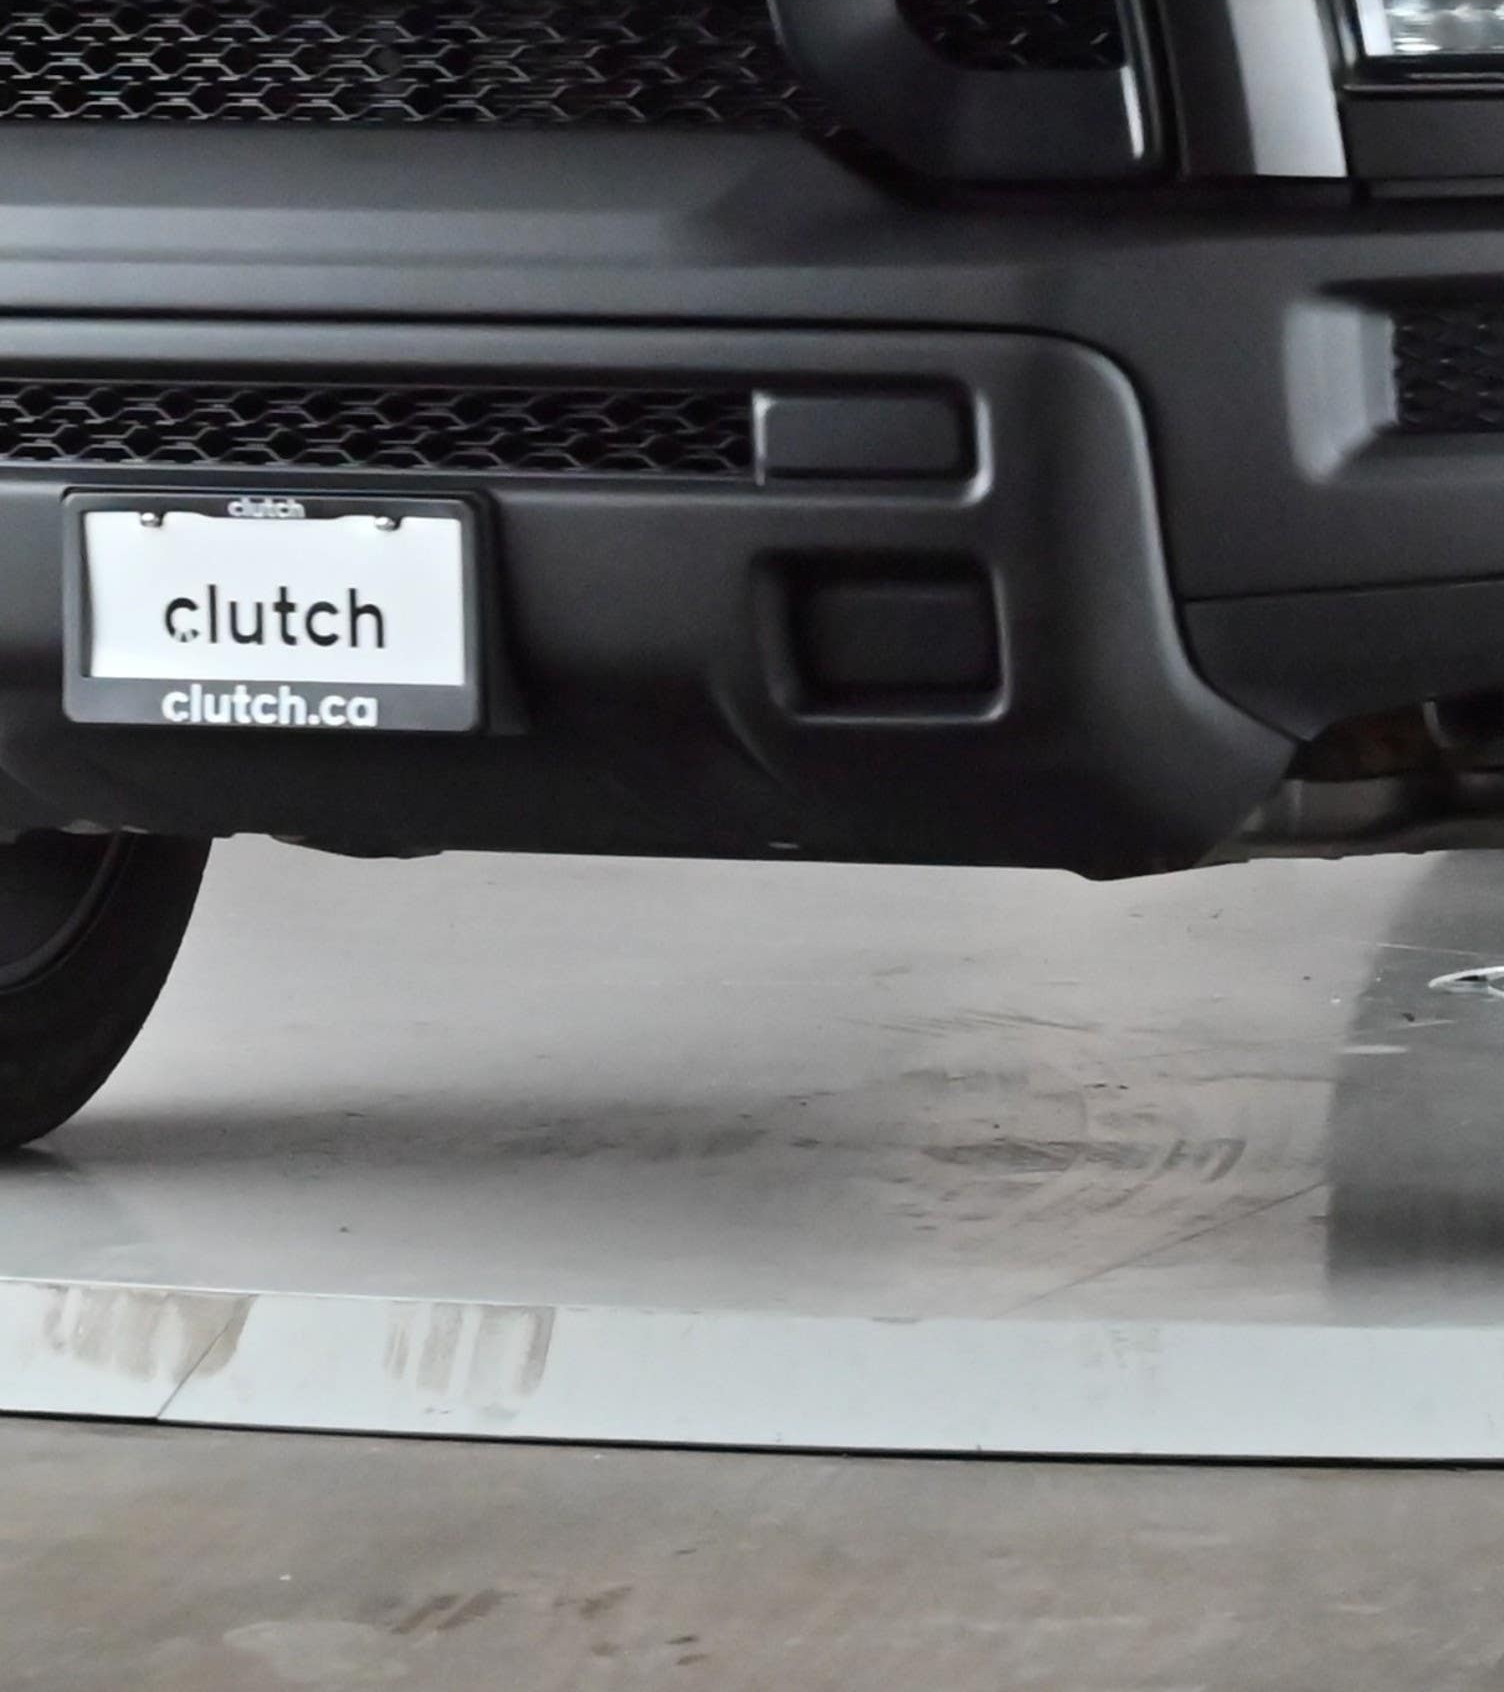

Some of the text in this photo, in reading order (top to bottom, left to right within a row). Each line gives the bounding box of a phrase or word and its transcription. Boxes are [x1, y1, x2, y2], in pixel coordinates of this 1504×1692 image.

[226, 496, 306, 518] clutch
[164, 584, 386, 649] clutch
[161, 683, 379, 728] clutch.ca
